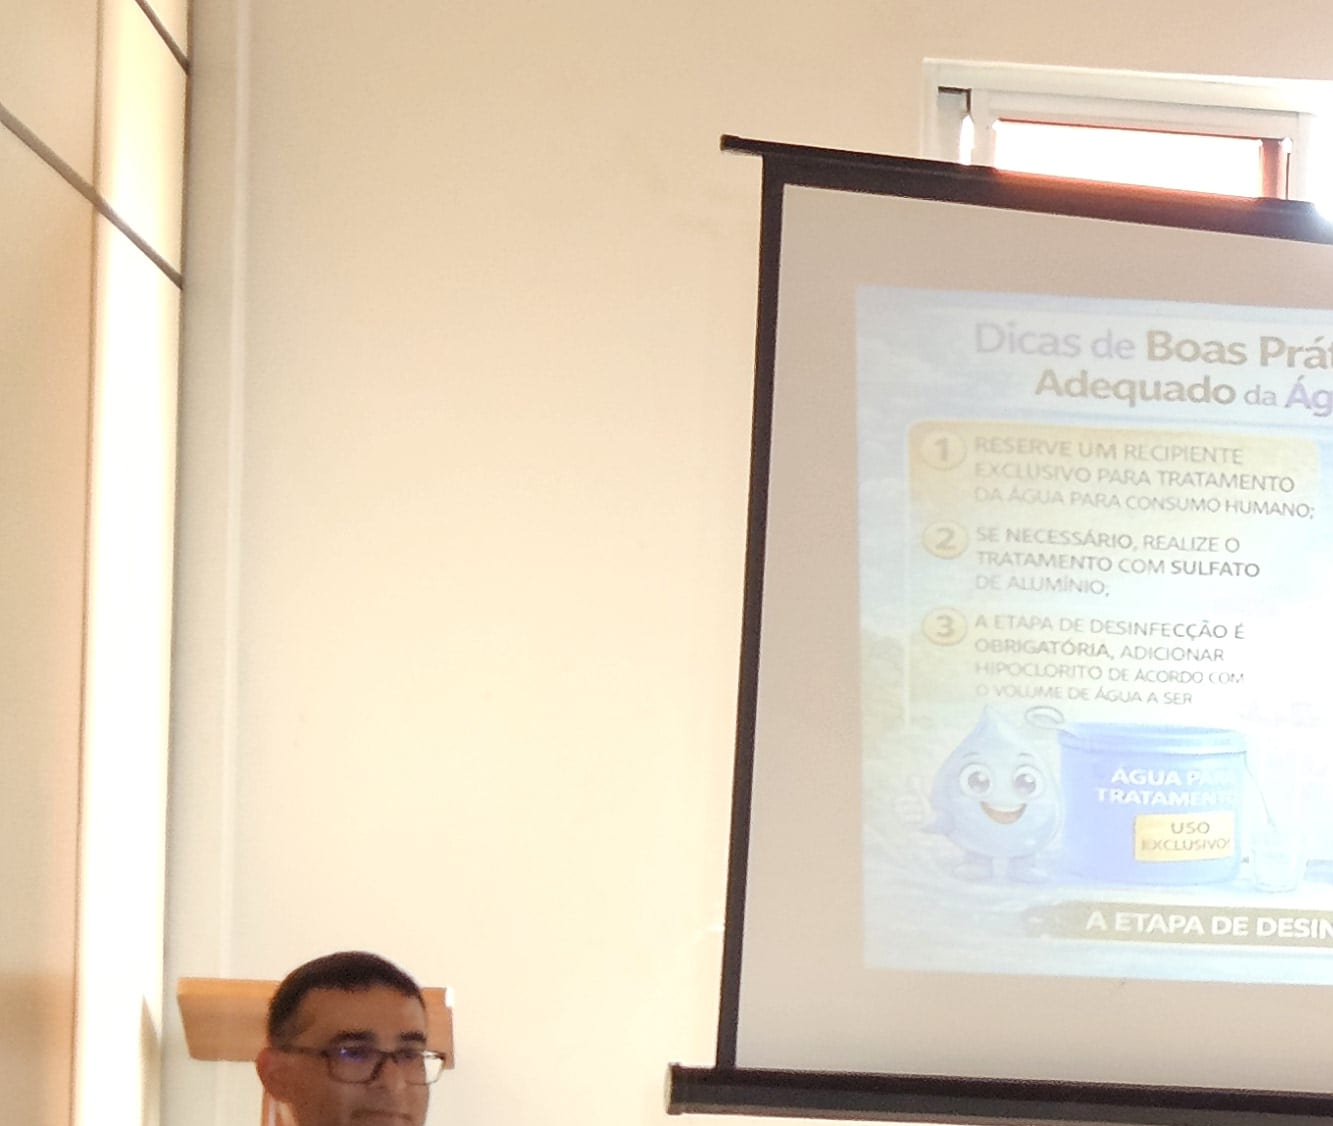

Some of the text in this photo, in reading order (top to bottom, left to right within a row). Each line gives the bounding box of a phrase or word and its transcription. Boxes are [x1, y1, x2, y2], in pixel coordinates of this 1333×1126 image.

[975, 322, 1081, 360] Dicas
[1091, 329, 1136, 360] de
[1146, 330, 1247, 366] Boas
[1034, 370, 1236, 407] Adequado
[1244, 385, 1277, 408] da
[934, 438, 951, 460] 1
[974, 436, 1244, 465] RESERVE UM RECIPIENTE
[974, 462, 1295, 494] EXCLUSIVO PARA TRATAMENTO
[974, 484, 1315, 520] DA ÁGUA PARA CONSUMO HUMANO;
[935, 528, 955, 549] 2
[976, 525, 1240, 553] SE NECESSÁRIO, REALIZE O
[976, 550, 1260, 578] TRATAMENTO COM SULFATO
[976, 575, 1001, 591] DE
[936, 616, 954, 637] 3
[974, 615, 1246, 642] A ETAPA DE DESINFECÇÃO É
[974, 637, 1225, 662] OBRIGATÓRIA, ADICIONAR
[974, 661, 1245, 685] HIPOCLORITO DE ACORDO COM
[976, 682, 1193, 705] O VOLUME DE ÁGUA A SER
[1111, 765, 1182, 786] ÁGUA
[1170, 821, 1211, 835] USO
[1086, 911, 1108, 930] A
[1114, 912, 1204, 934] ETAPA
[1211, 917, 1250, 937] DE
